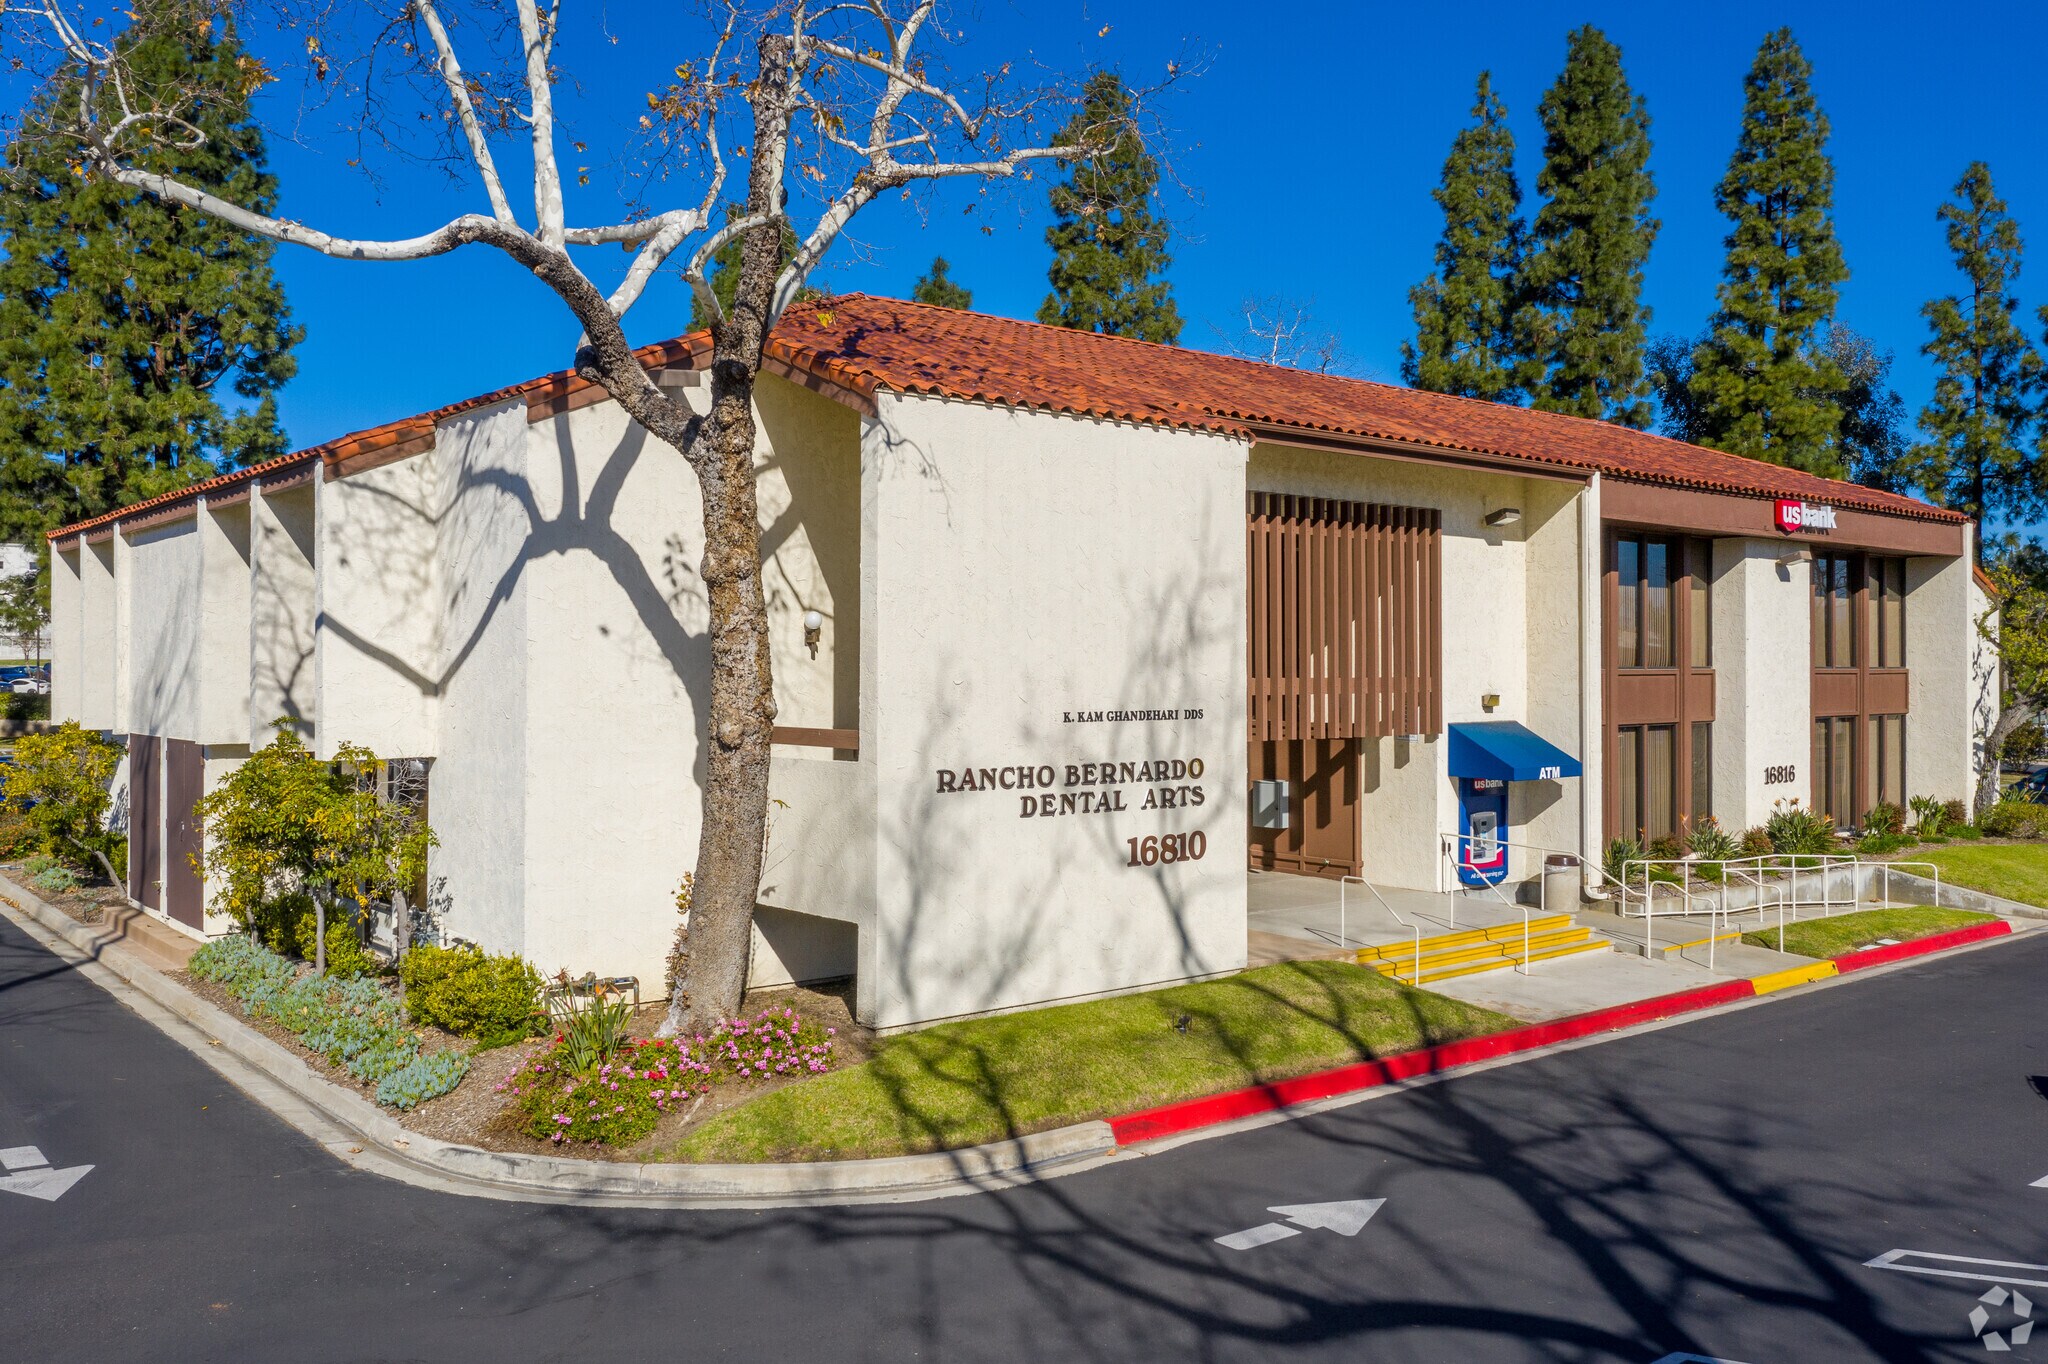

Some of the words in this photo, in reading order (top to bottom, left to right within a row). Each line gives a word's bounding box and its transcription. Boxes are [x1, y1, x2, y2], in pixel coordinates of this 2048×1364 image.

[1063, 711, 1075, 723] K.
[1077, 711, 1104, 722] KAM
[1106, 710, 1179, 721] GHANDEHARI
[1183, 709, 1204, 720] DDS
[936, 765, 1056, 793] RANCHO
[1064, 758, 1205, 787] BERNARDO
[1539, 766, 1560, 780] ATM
[1764, 764, 1796, 784] 16816
[1019, 790, 1128, 819] DENTAL
[1140, 786, 1206, 811] ARTS
[1127, 830, 1207, 867] 16810
